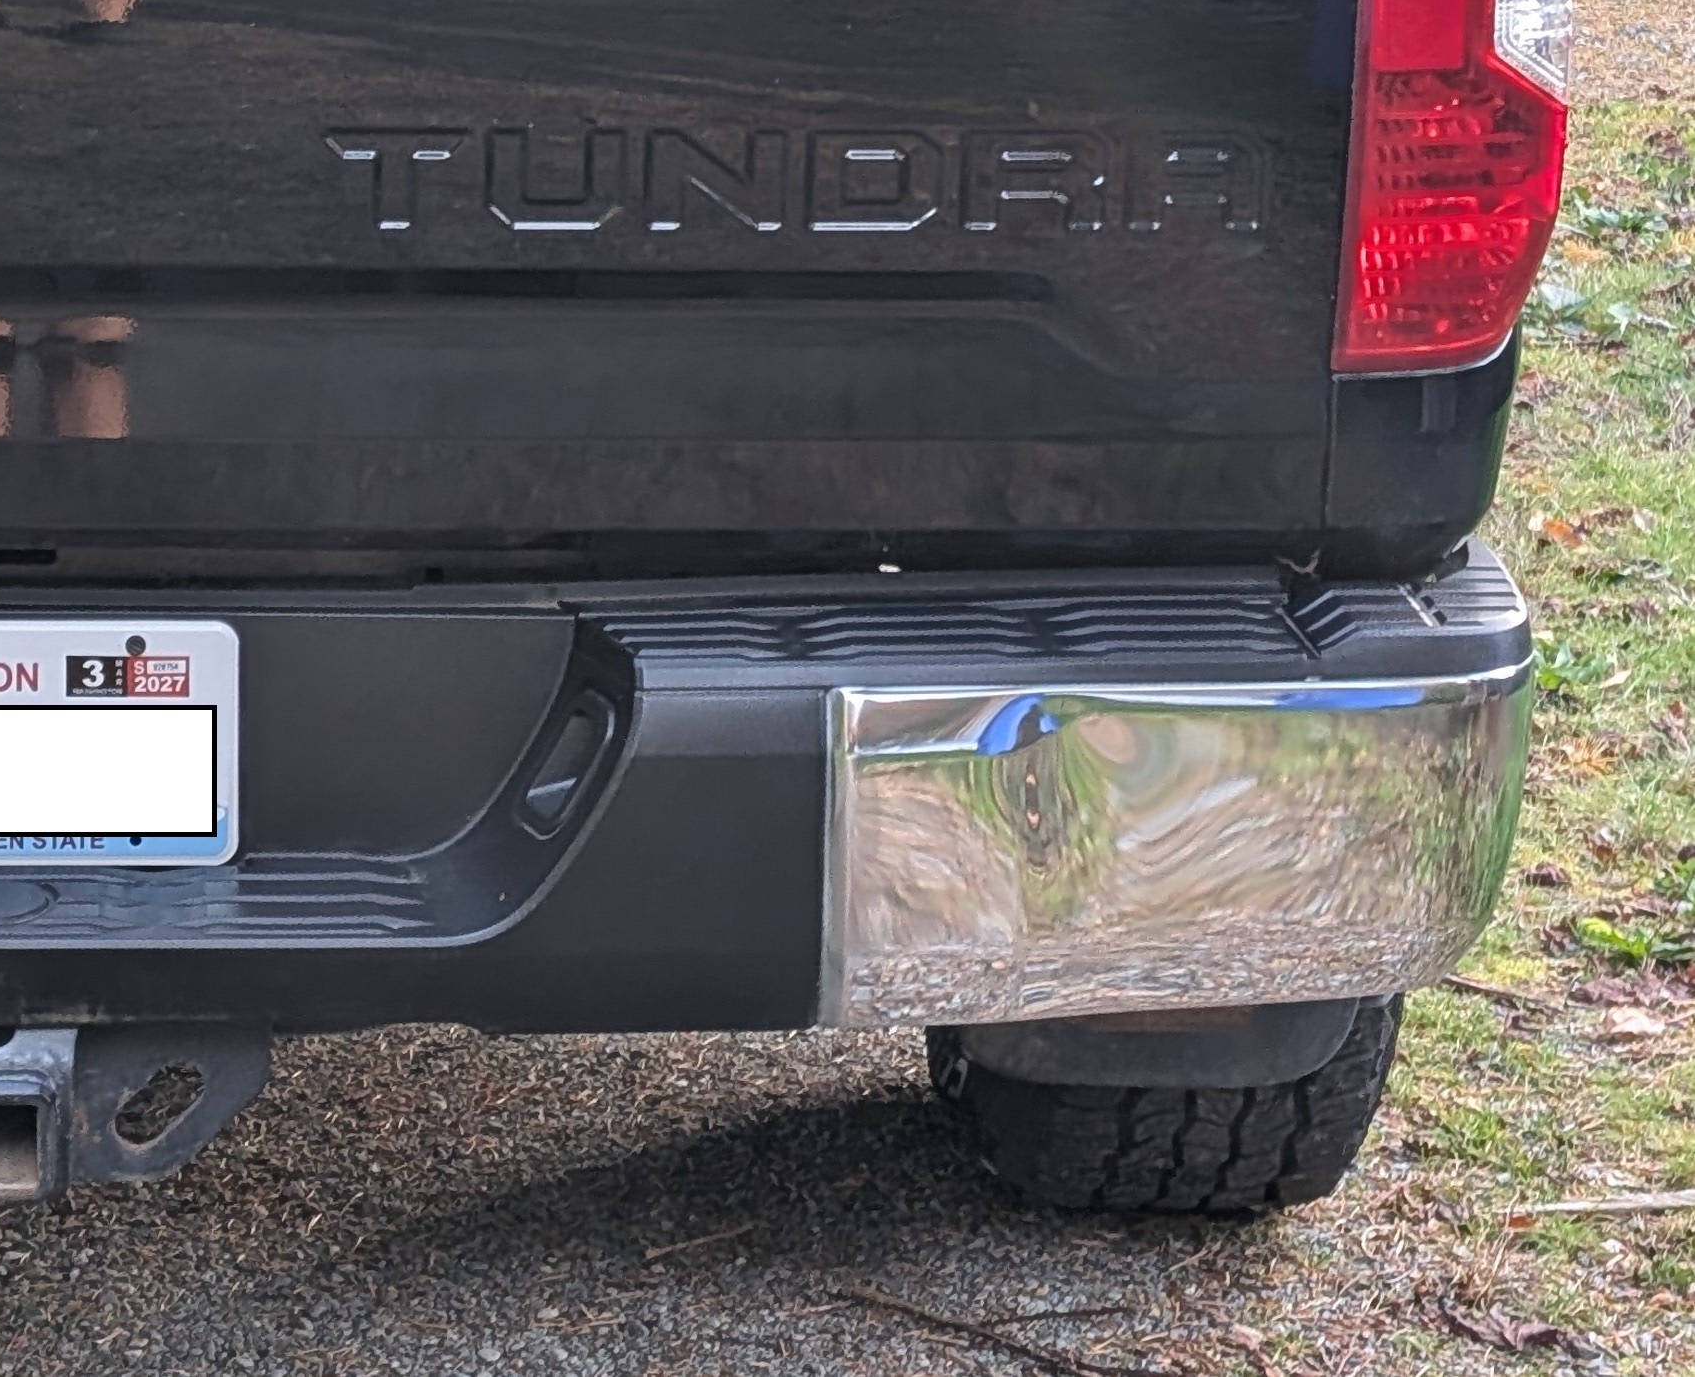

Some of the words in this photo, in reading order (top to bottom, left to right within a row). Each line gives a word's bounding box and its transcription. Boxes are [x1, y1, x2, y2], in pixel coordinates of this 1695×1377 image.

[323, 125, 1272, 231] TUNDRA
[82, 660, 105, 688] 3
[134, 676, 186, 693] 2027
